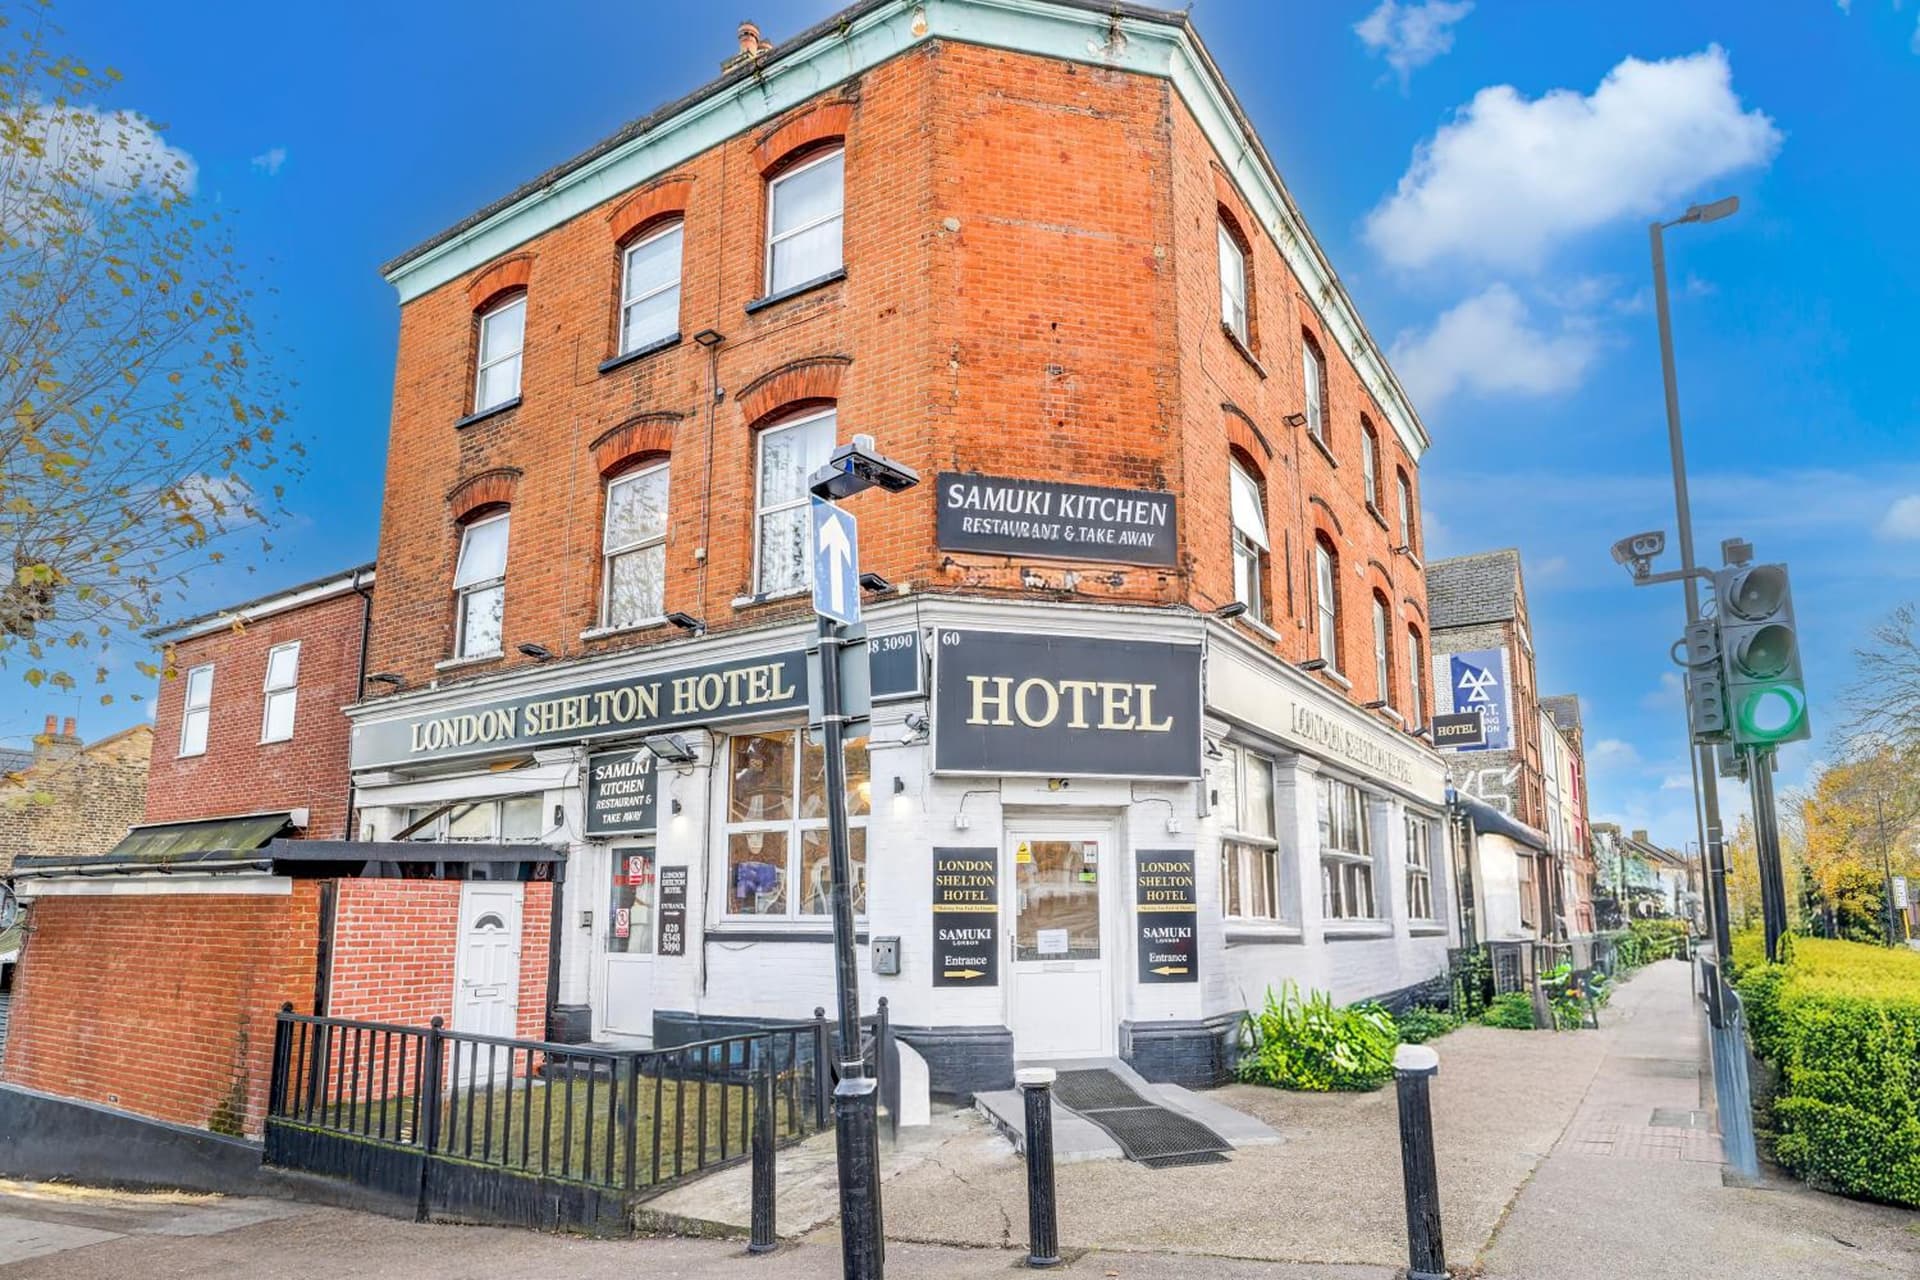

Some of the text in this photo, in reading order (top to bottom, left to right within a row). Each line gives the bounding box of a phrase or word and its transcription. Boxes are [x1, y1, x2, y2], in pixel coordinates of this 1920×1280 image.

[947, 483, 1168, 527] SAMUKI KITCHEN
[962, 516, 1156, 547] RESTAURANT & TAKE AWAY
[882, 634, 913, 652] 3090
[942, 631, 961, 646] 60
[410, 662, 796, 753] LONDON SHELTON HOTEL
[965, 675, 1174, 733] HOTEL
[1436, 724, 1477, 737] HOTEL
[595, 758, 651, 780] SAMUKI
[600, 778, 645, 797] KITCHEN
[596, 794, 652, 810] RESTAURANT &
[602, 810, 642, 824] TAKE AWAY
[938, 860, 993, 871] LONDON
[1141, 862, 1192, 873] LONDON
[936, 875, 995, 887] SHELTON
[1138, 876, 1193, 887] SHELTON
[943, 890, 989, 901] HOTEL
[1146, 890, 1188, 901] HOTEL
[939, 928, 992, 940] SAMUKI
[1143, 927, 1191, 938] SAMUKI
[945, 955, 987, 966] Entrance
[1149, 952, 1188, 963] Entrance
